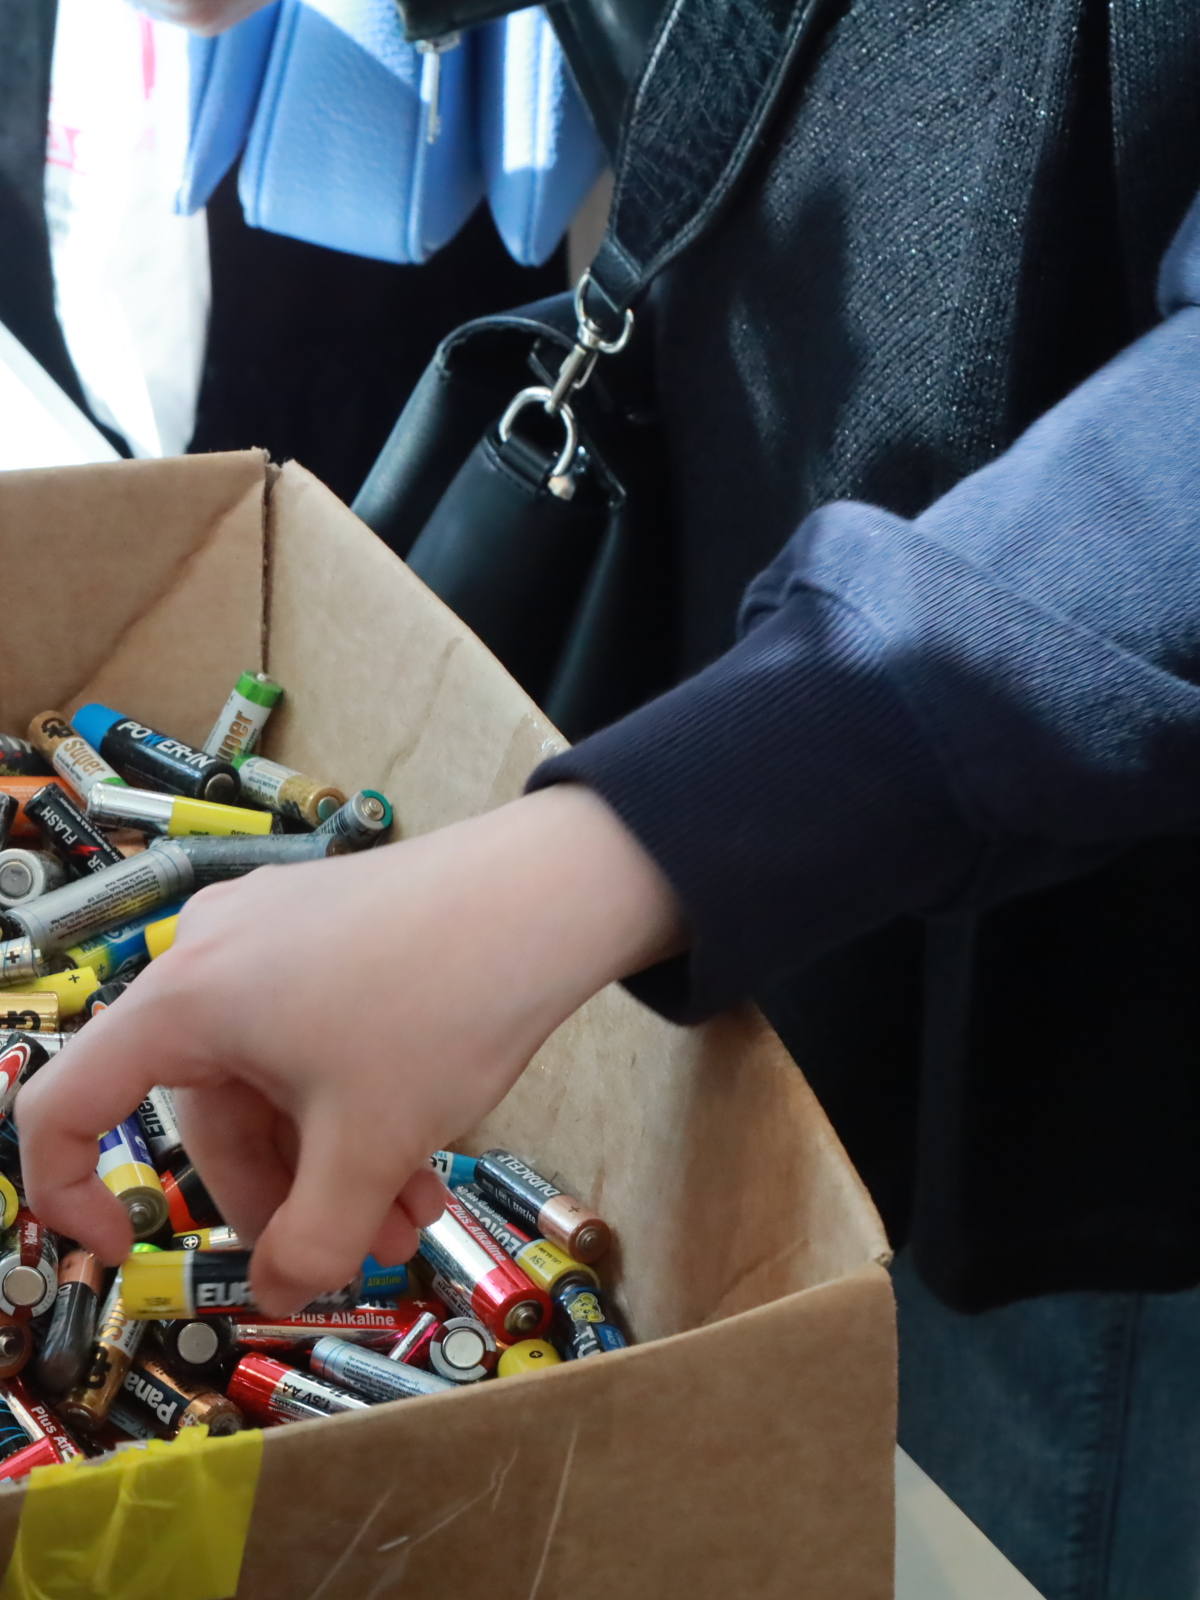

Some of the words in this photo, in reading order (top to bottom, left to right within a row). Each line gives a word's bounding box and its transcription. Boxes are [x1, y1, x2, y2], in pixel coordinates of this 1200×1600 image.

[62, 737, 105, 776] Super
[117, 721, 216, 768] POWER-IN
[40, 805, 78, 845] FLASH
[505, 1155, 561, 1198] DURACELL
[449, 1203, 472, 1227] Plus
[470, 1224, 507, 1262] Alkaline
[527, 1251, 547, 1270] 1.5V
[367, 1274, 402, 1288] Alkaline
[290, 1312, 326, 1324] Plus
[330, 1311, 395, 1326] Alkaline
[282, 1381, 300, 1394] AA
[303, 1390, 331, 1410] 1.5V
[30, 1405, 57, 1436] Plus
